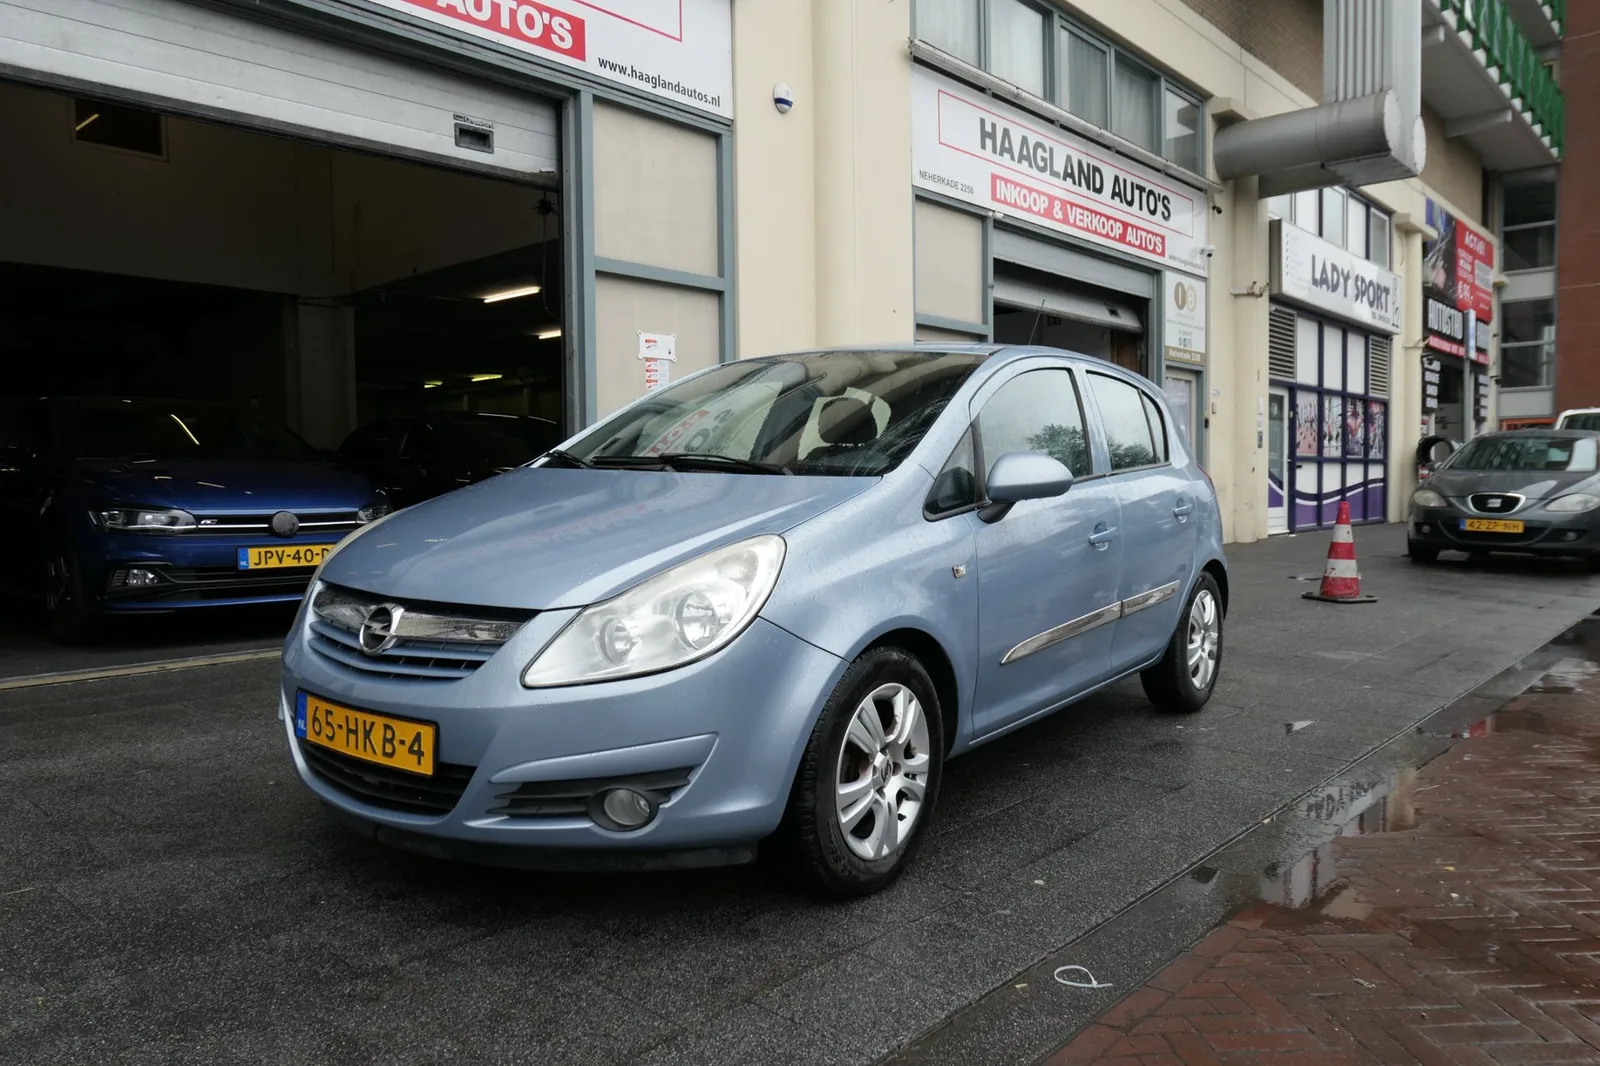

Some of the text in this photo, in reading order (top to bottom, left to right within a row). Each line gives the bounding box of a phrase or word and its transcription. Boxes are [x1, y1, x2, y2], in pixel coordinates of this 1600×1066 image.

[597, 57, 721, 108] www.haaglandautos.nl
[919, 169, 959, 190] NEHERKADE
[979, 116, 1172, 222] HAAGLAND AUTO'S
[996, 178, 1163, 253] INKOOP & VERKOOP AUTO'S
[1311, 254, 1351, 298] LADY
[1354, 274, 1390, 313] SPORT
[312, 705, 425, 766] 65-HKB-4
